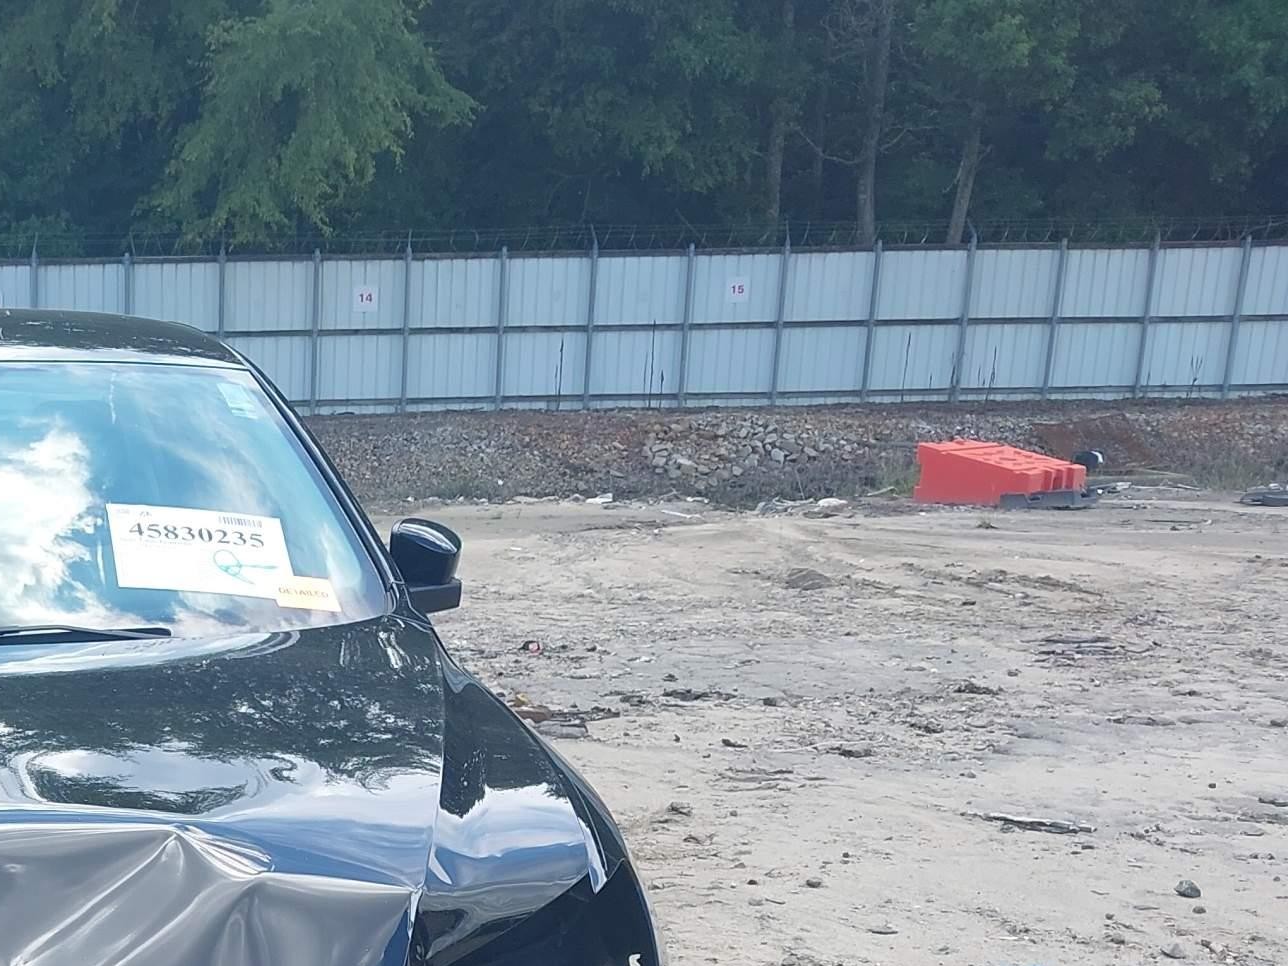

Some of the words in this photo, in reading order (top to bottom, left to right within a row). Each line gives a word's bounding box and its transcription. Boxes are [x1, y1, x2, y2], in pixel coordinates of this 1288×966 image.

[731, 285, 745, 296] 15
[359, 293, 373, 303] 14
[129, 522, 265, 549] 45830235
